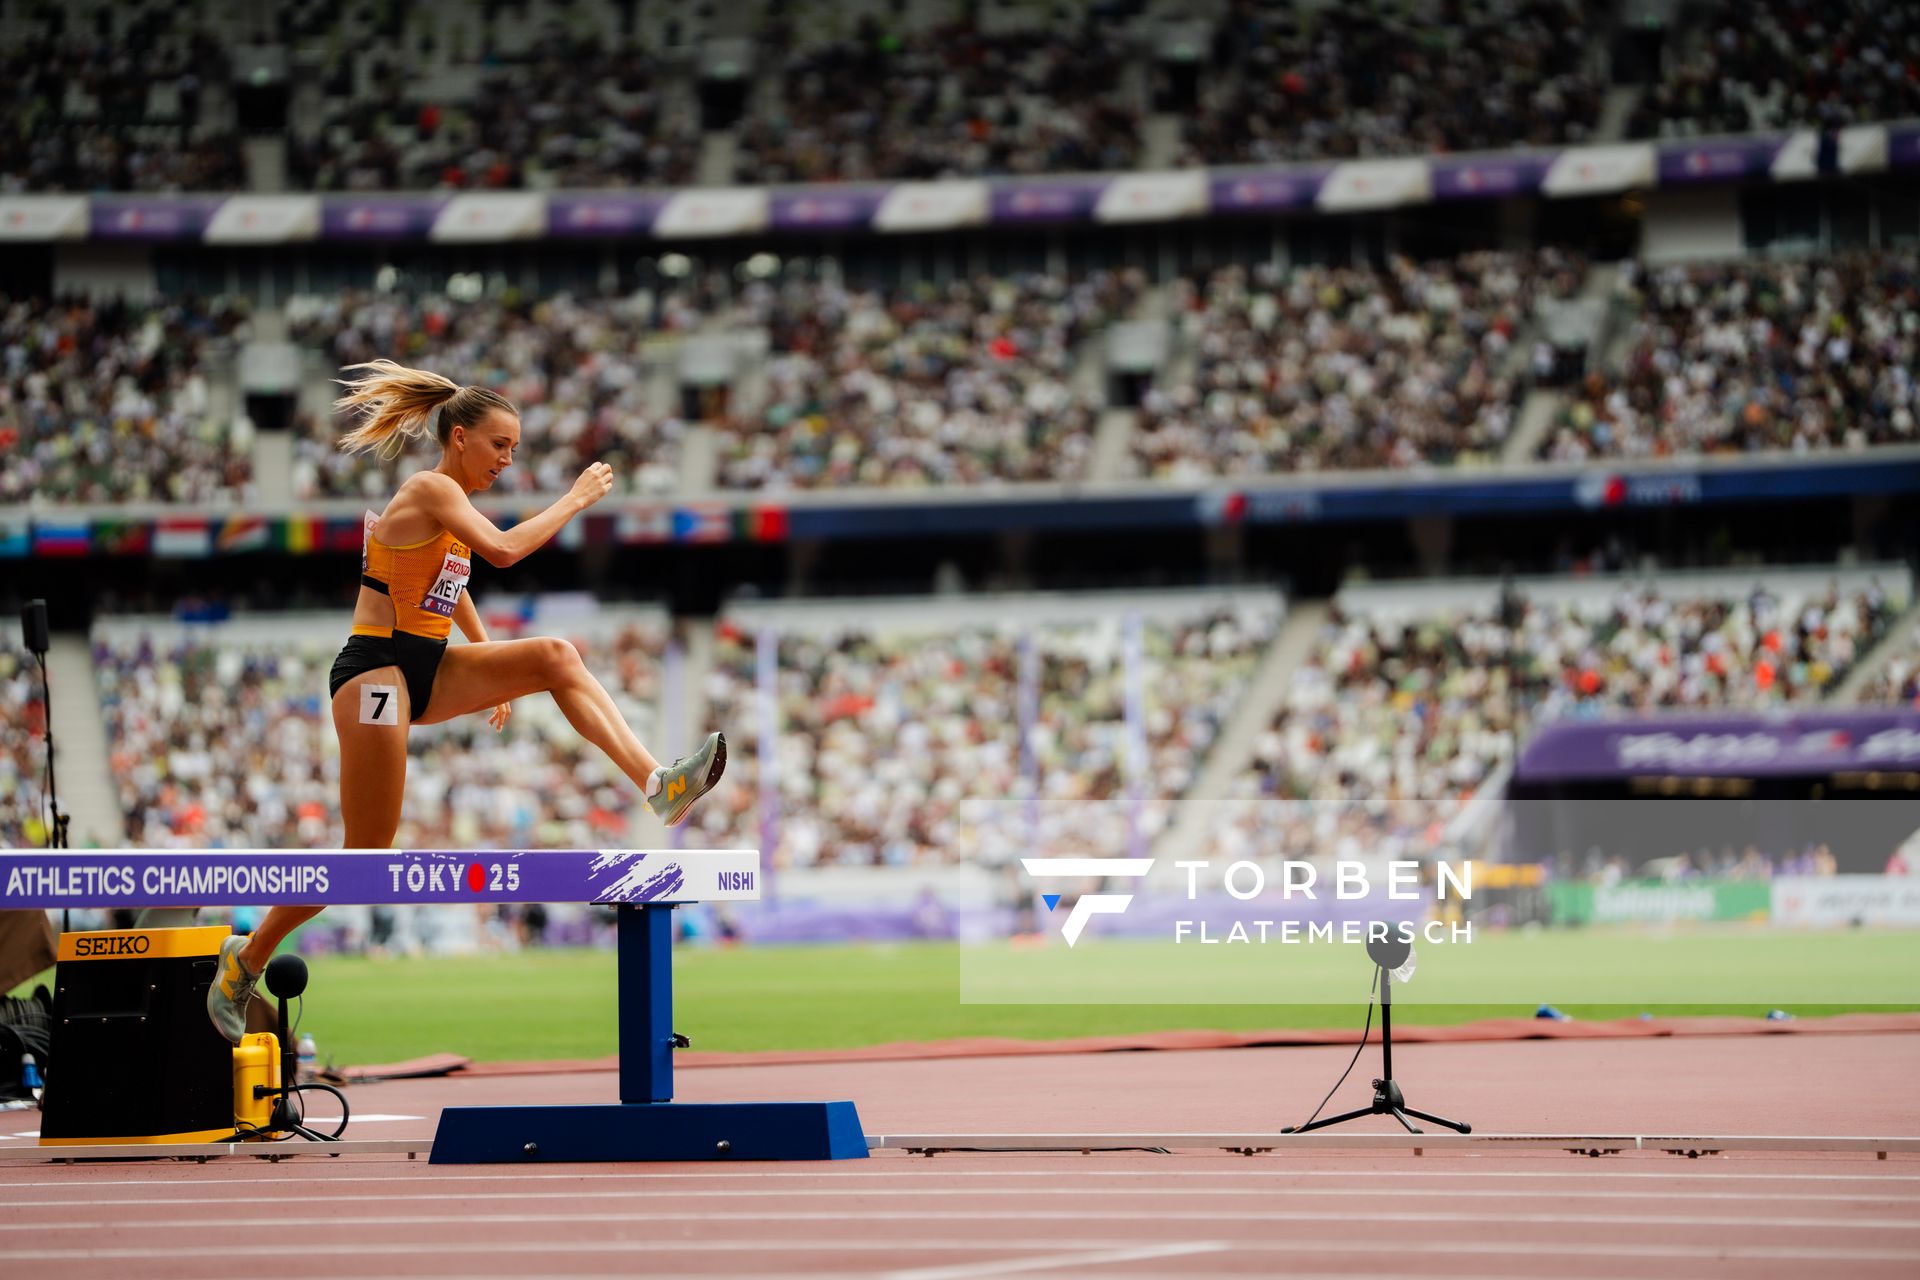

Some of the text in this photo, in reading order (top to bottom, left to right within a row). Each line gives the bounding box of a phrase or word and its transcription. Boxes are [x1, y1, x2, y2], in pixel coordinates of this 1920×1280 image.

[444, 559, 470, 577] HOND
[371, 692, 389, 719] 7
[6, 865, 329, 896] ATHLETICS CHAMPIONSHIPS
[718, 871, 754, 891] NISHI
[75, 935, 150, 957] SEIKO
